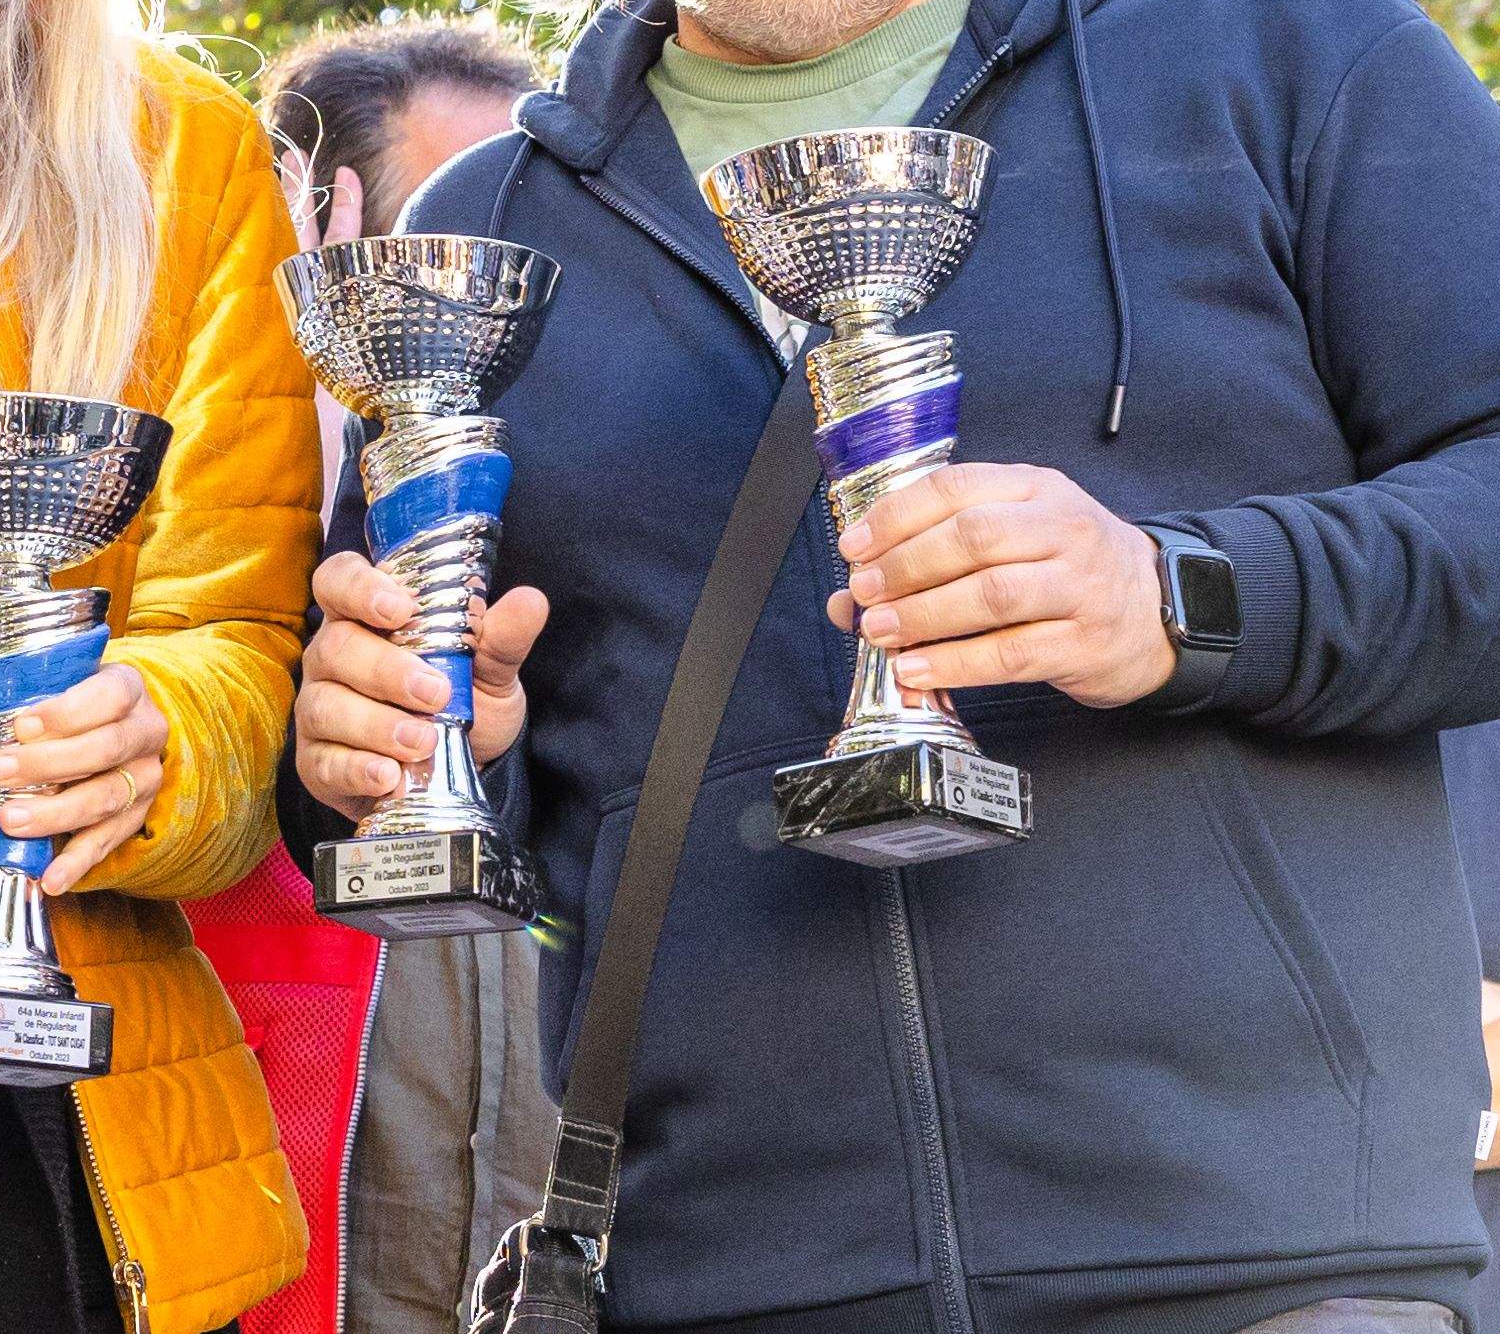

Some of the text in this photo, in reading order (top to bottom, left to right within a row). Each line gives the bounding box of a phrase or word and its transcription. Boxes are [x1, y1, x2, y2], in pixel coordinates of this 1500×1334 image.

[391, 843, 414, 851] Marxa
[417, 839, 441, 849] Infantil
[382, 852, 434, 864] de Regularitat
[389, 883, 429, 894] Octubre 2023
[18, 1007, 84, 1020] 64a Marxa Infantil
[25, 1020, 34, 1028] de
[37, 1020, 77, 1031] Regularitat
[29, 1051, 70, 1062] Octubre 2023
